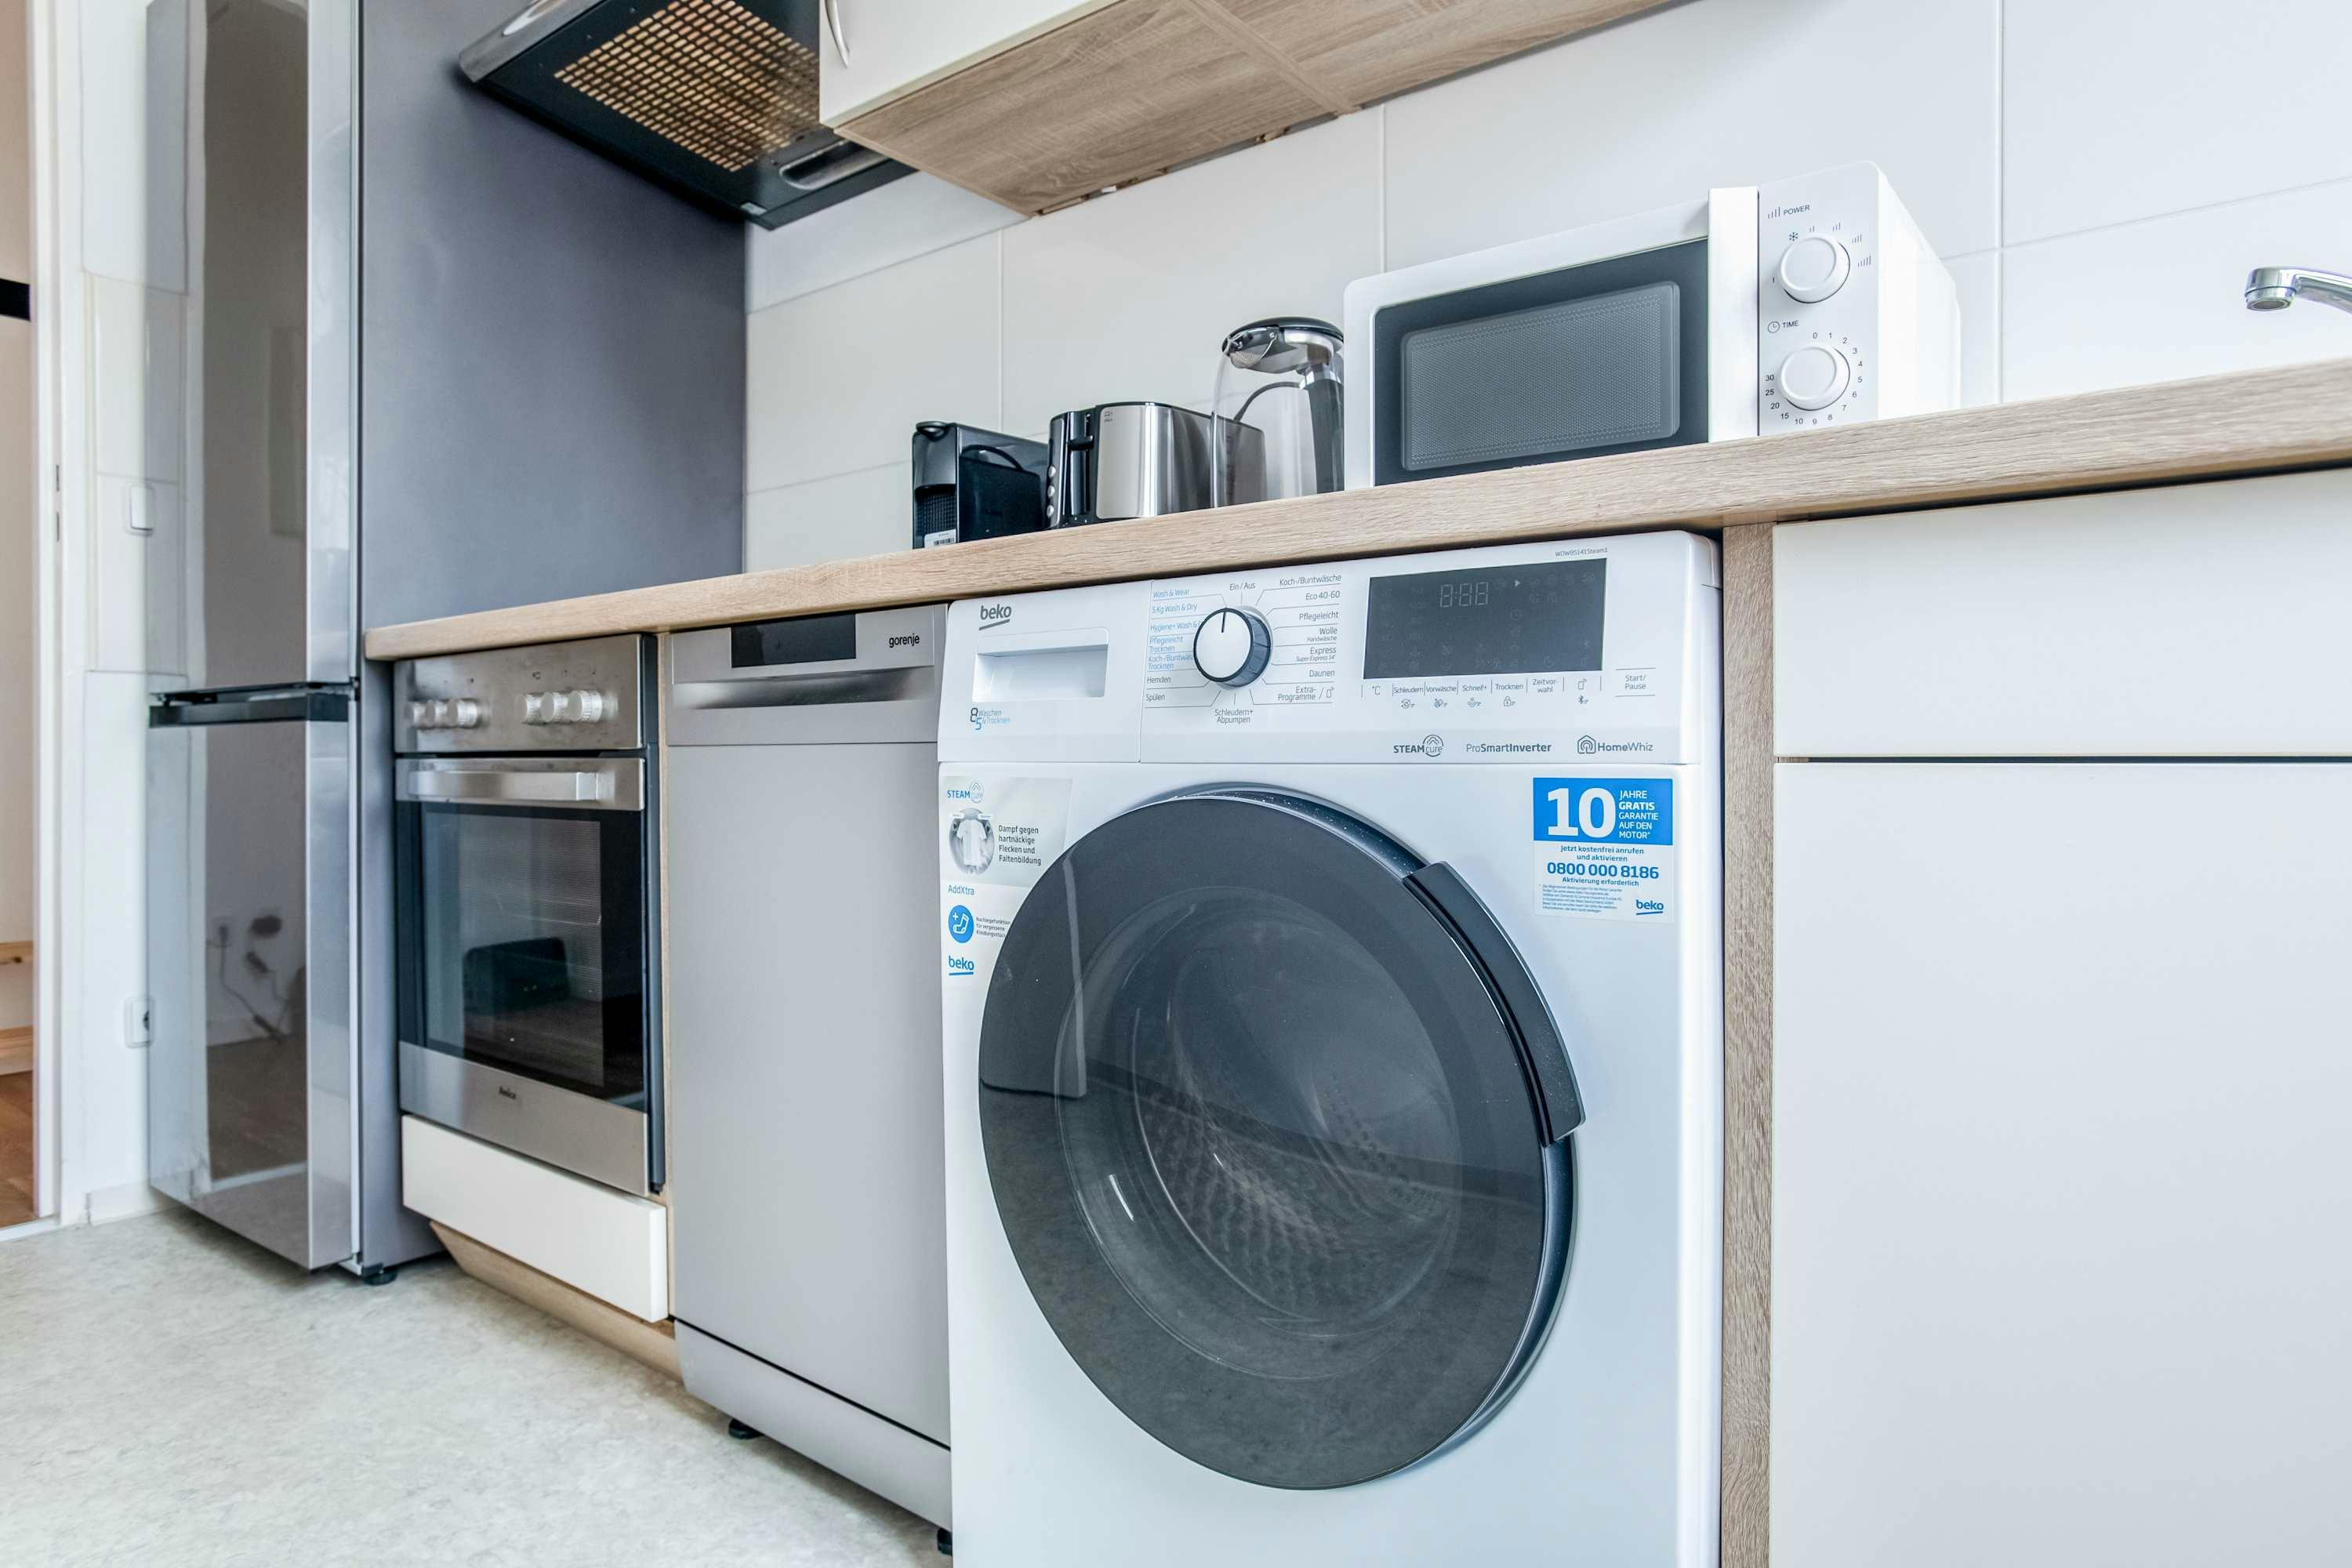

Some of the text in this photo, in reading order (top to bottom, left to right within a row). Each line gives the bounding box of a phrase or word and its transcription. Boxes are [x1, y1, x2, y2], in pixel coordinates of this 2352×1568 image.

[1783, 205, 1810, 216] POWER
[1279, 574, 1341, 586] Koch-/Buntwäsche
[1305, 590, 1340, 601] Eco 40-60
[980, 604, 1012, 620] beko
[1186, 603, 1197, 612] Dry
[1299, 612, 1338, 622] Pflegeleicht
[888, 633, 920, 648] gorenje
[1149, 636, 1183, 645] Pflegeleicht
[1310, 647, 1336, 655] Express
[1625, 673, 1647, 682] Start/
[1372, 685, 1381, 695] °C
[1496, 682, 1523, 691] Trocknen
[1145, 693, 1165, 702] Spülen
[1278, 693, 1316, 702] Programme
[1214, 708, 1253, 717] Schleudern+
[1217, 716, 1250, 725] Abpumpen
[1466, 743, 1552, 753] ProSmartInverter
[1598, 742, 1653, 752] HomeWhiz
[1620, 790, 1647, 800] JAHRE
[1618, 801, 1655, 811] GRATIS
[1548, 787, 1616, 838] 10
[1618, 811, 1658, 821] GARANTIE
[999, 825, 1018, 833] Dampf
[999, 835, 1035, 845] hartnäckige
[999, 855, 1041, 866] Faltenbildung
[1547, 862, 1659, 879] 0800 000 8186
[1562, 877, 1600, 886] Aktivierung
[948, 884, 975, 895] AddXtra
[1635, 899, 1664, 911] beko
[948, 956, 975, 971] beko
